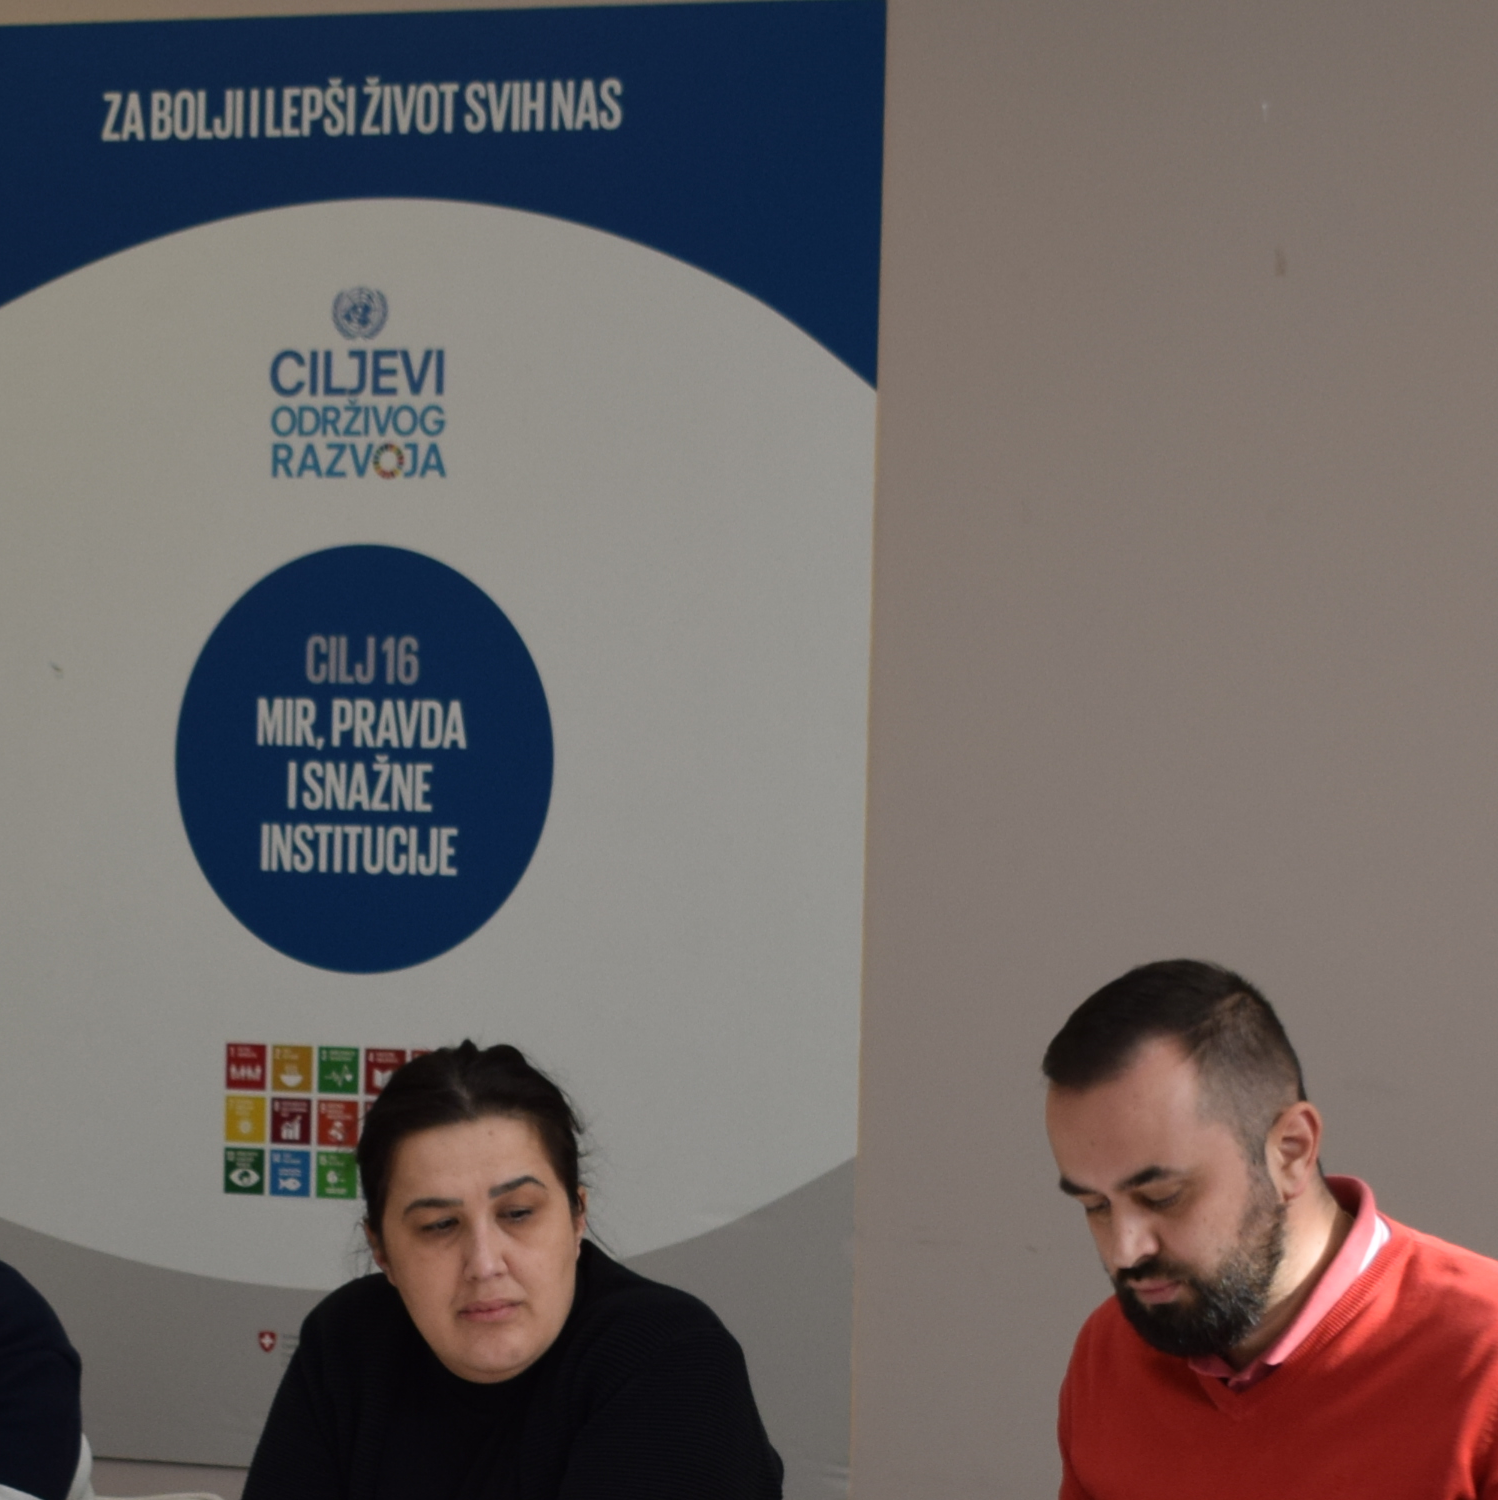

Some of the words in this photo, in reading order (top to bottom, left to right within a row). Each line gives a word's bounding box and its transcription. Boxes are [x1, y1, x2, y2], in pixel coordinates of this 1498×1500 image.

[101, 91, 145, 142] ZA
[150, 88, 243, 140] BOLJI
[249, 88, 259, 139] I
[264, 77, 355, 138] LEPŠI
[361, 76, 459, 136] ŽIVOT
[464, 80, 545, 133] SVIH
[551, 77, 623, 132] NAS
[269, 348, 446, 397] CILJEVI
[270, 398, 446, 437] ODRŽIVOG
[271, 443, 447, 479] RAZVOJA
[305, 636, 376, 685] CILJ
[381, 635, 419, 685] 16
[256, 698, 325, 750] MIR,
[331, 700, 467, 750] PRAVDA
[287, 760, 297, 810] I
[303, 754, 433, 813] SNAŽNE
[259, 823, 459, 877] INSTITUCIJE
